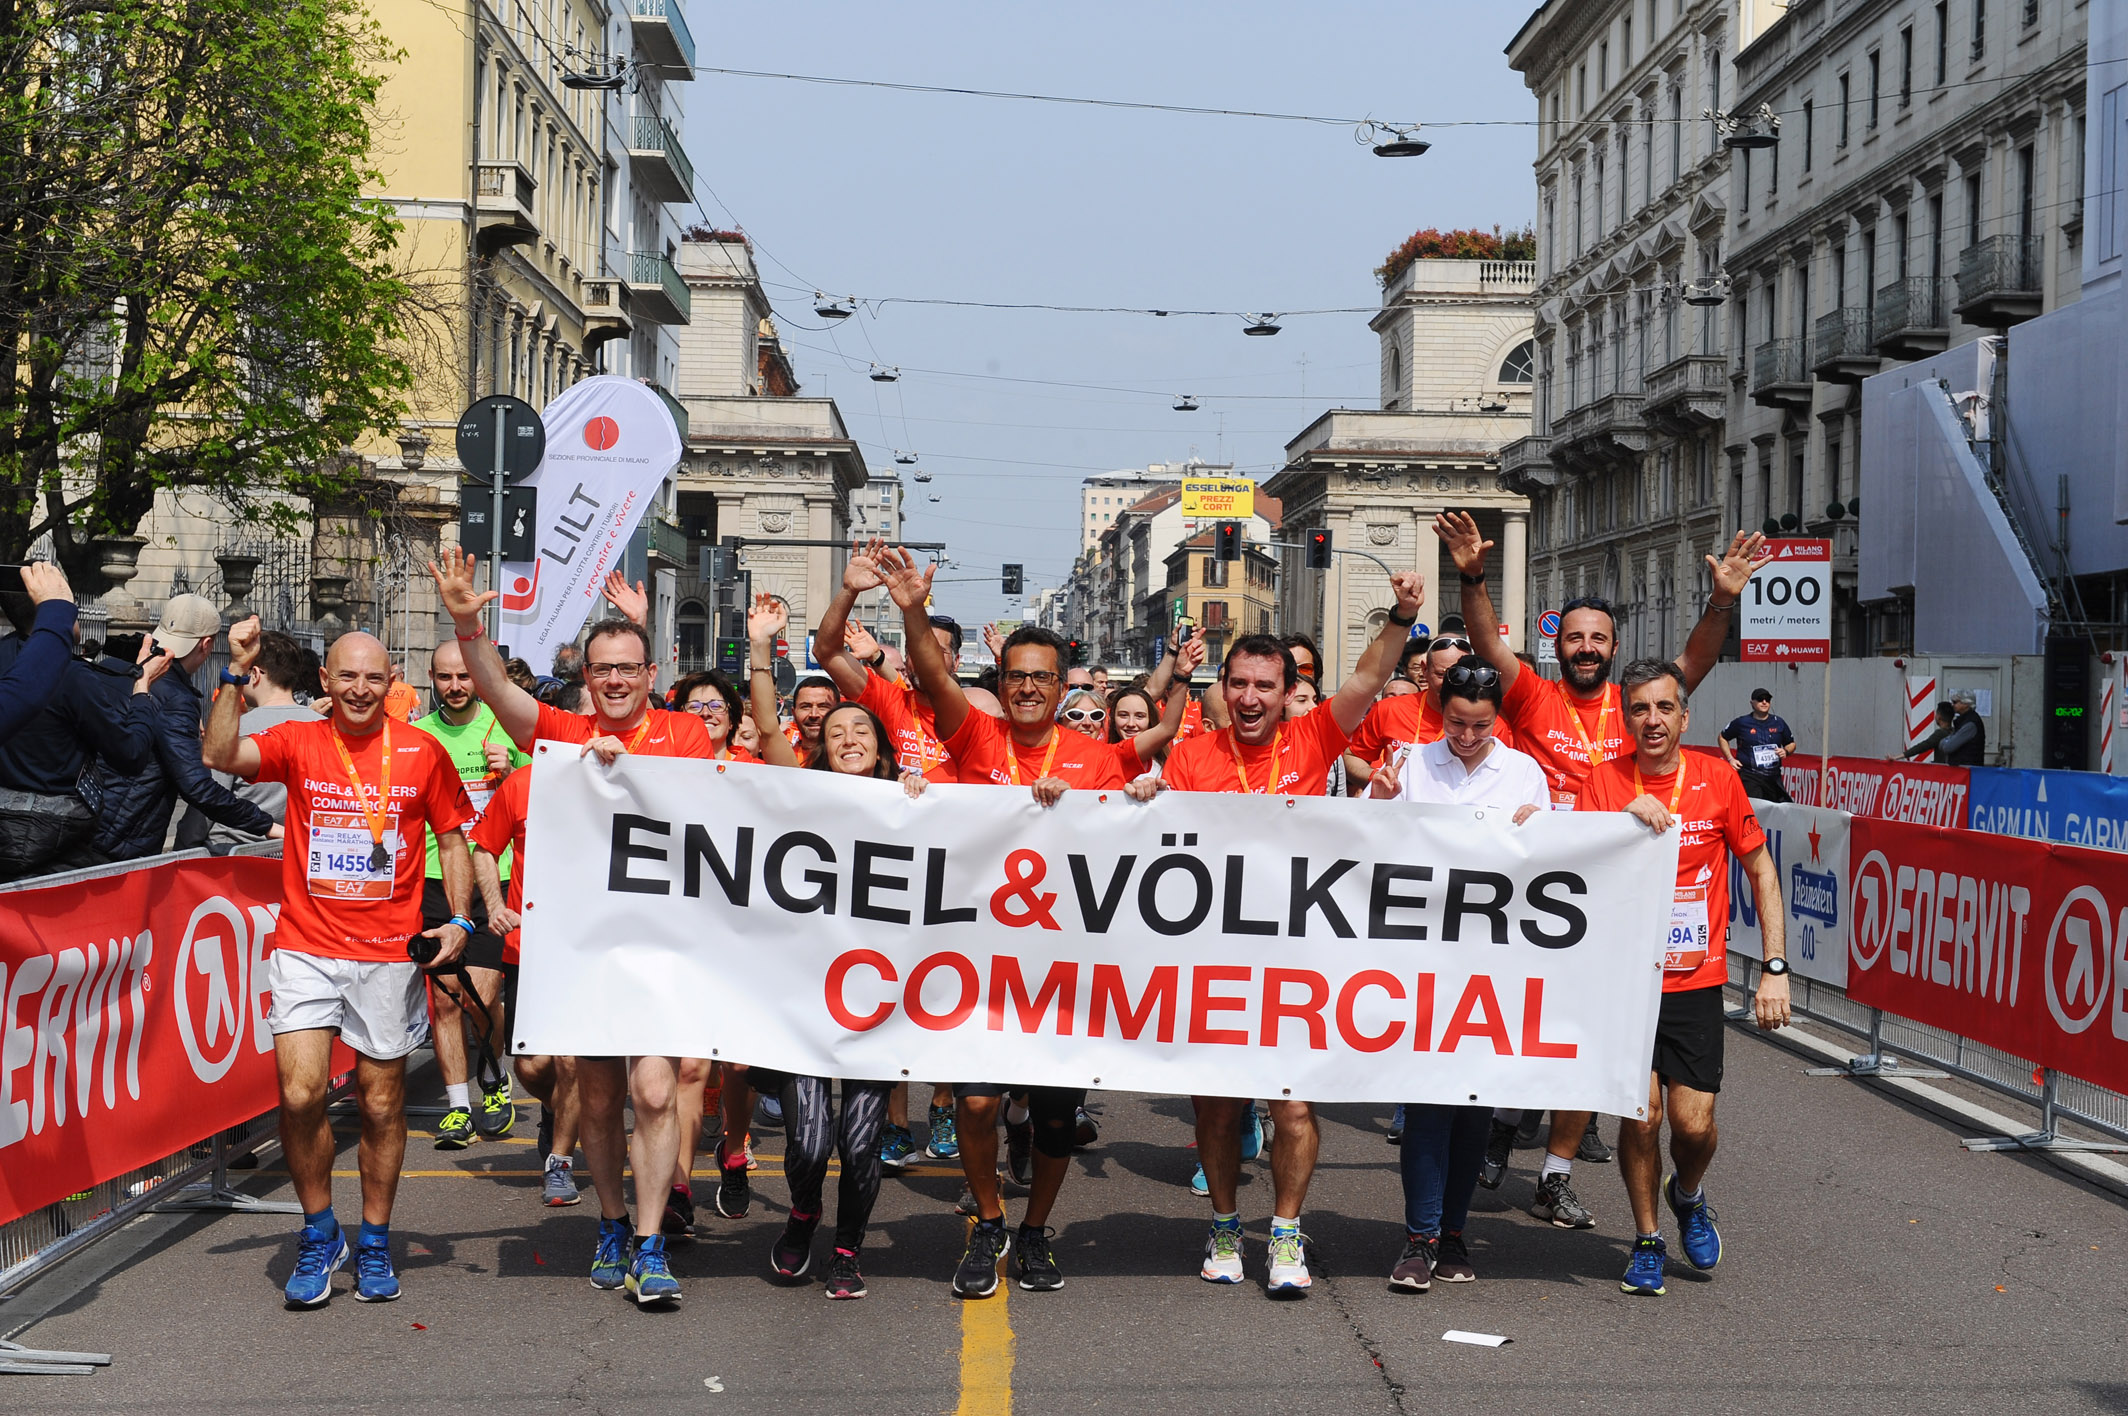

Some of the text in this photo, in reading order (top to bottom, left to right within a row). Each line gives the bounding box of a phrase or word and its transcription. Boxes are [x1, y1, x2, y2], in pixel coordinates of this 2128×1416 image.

[548, 453, 575, 461] SEZIONE
[576, 455, 617, 463] PROVINCIALE
[1200, 495, 1235, 503] PREZZI
[1203, 503, 1232, 511] CORTI
[541, 482, 600, 565] LILT
[584, 541, 614, 598] prevenire
[615, 490, 637, 527] vivere
[1759, 545, 1771, 555] A7
[537, 628, 550, 645] LEGA
[546, 599, 566, 629] ITALIANA
[563, 587, 572, 599] PER
[575, 556, 589, 577] LOTTA
[585, 530, 603, 557] CONTRO
[601, 502, 619, 527] TUMORI
[1749, 576, 1820, 606] 100
[1750, 616, 1776, 624] metri
[1786, 616, 1820, 624] meters
[1747, 643, 1769, 653] EA7
[303, 778, 418, 798] ENGEL&ÖLERS
[1839, 771, 1883, 817] ENERVIT
[1899, 778, 1967, 828] ENERVIT
[1973, 804, 2049, 840] GARMIN
[335, 881, 366, 893] EA7
[609, 814, 1587, 948] ENGEL&VÖLKERS
[1793, 874, 1834, 915] Heineken
[1890, 865, 2030, 1008] ENERVIT
[825, 949, 1577, 1058] COMMERCIAL
